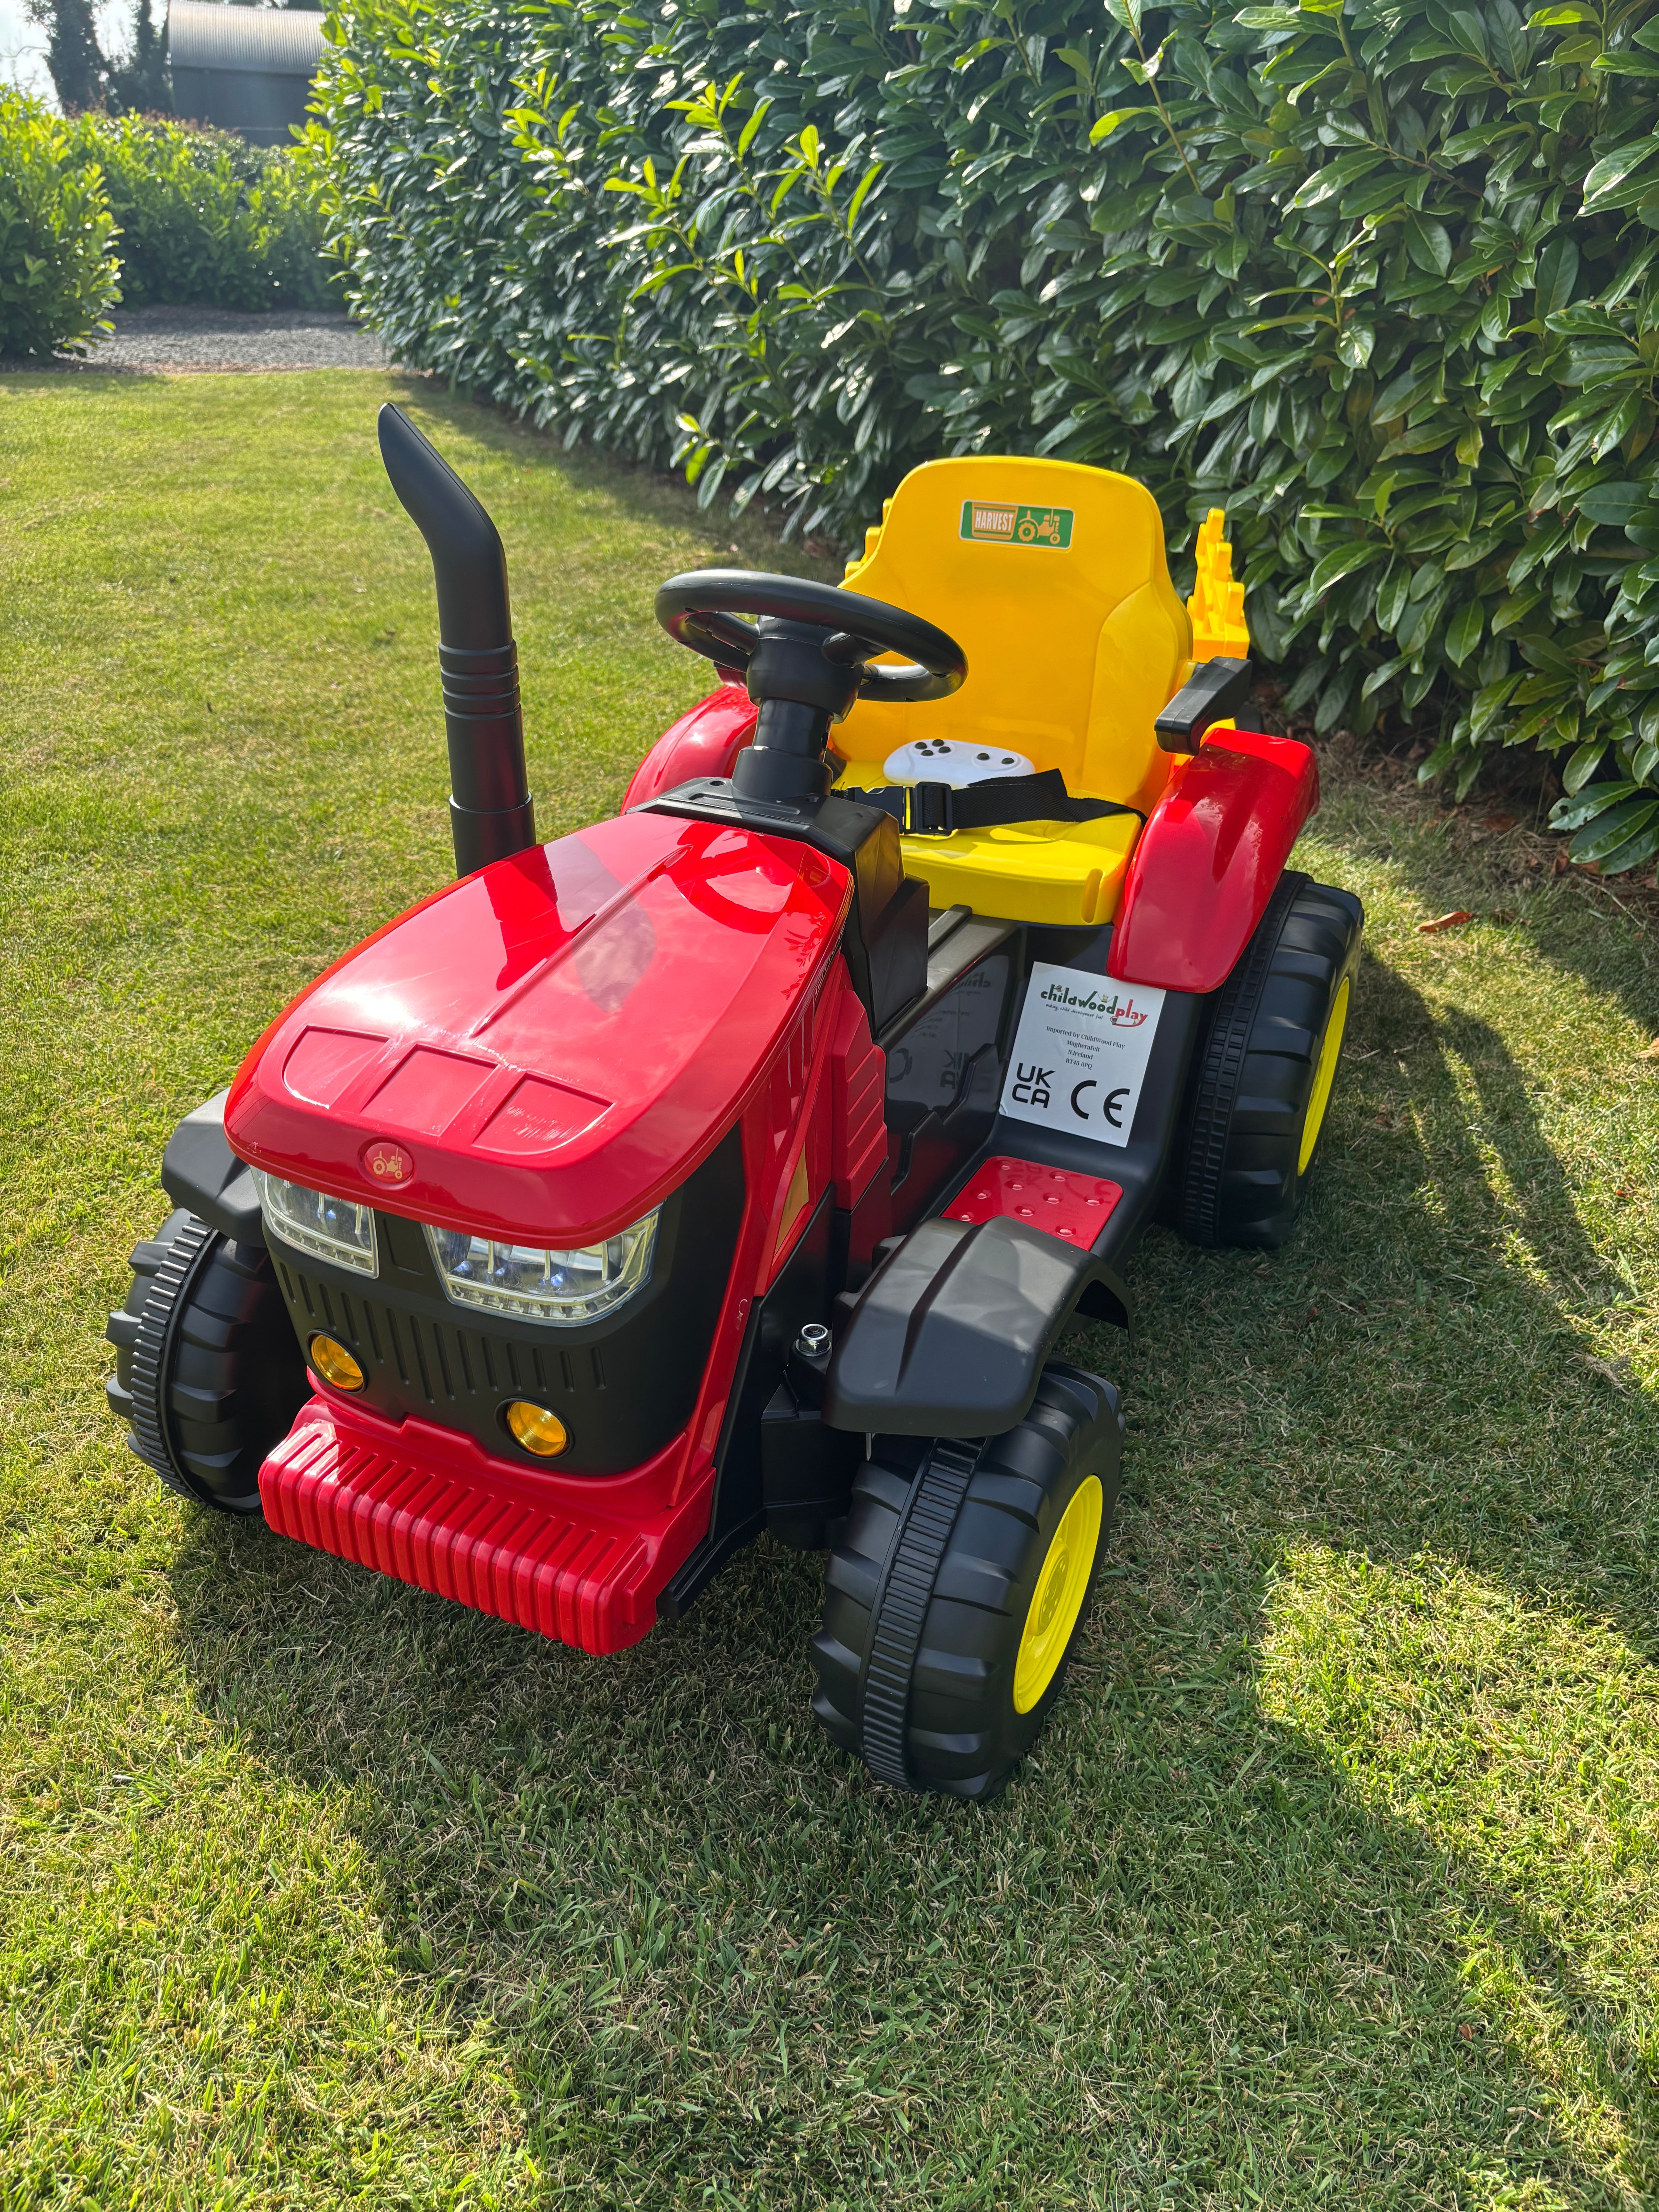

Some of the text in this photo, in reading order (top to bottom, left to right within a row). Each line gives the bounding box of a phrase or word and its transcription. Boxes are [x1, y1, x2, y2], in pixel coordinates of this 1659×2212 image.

[975, 511, 1013, 531] HARVEST
[1041, 984, 1148, 1027] childwoodplay
[1071, 1009, 1094, 1018] development
[1046, 1026, 1072, 1036] Imported
[1081, 1034, 1112, 1046] ChildWood
[1066, 1040, 1100, 1052] Magherafelt
[1068, 1049, 1093, 1060] N.Ireland
[1017, 1063, 1056, 1089] UK
[1012, 1084, 1050, 1108] CA
[1070, 1080, 1130, 1128] CE
